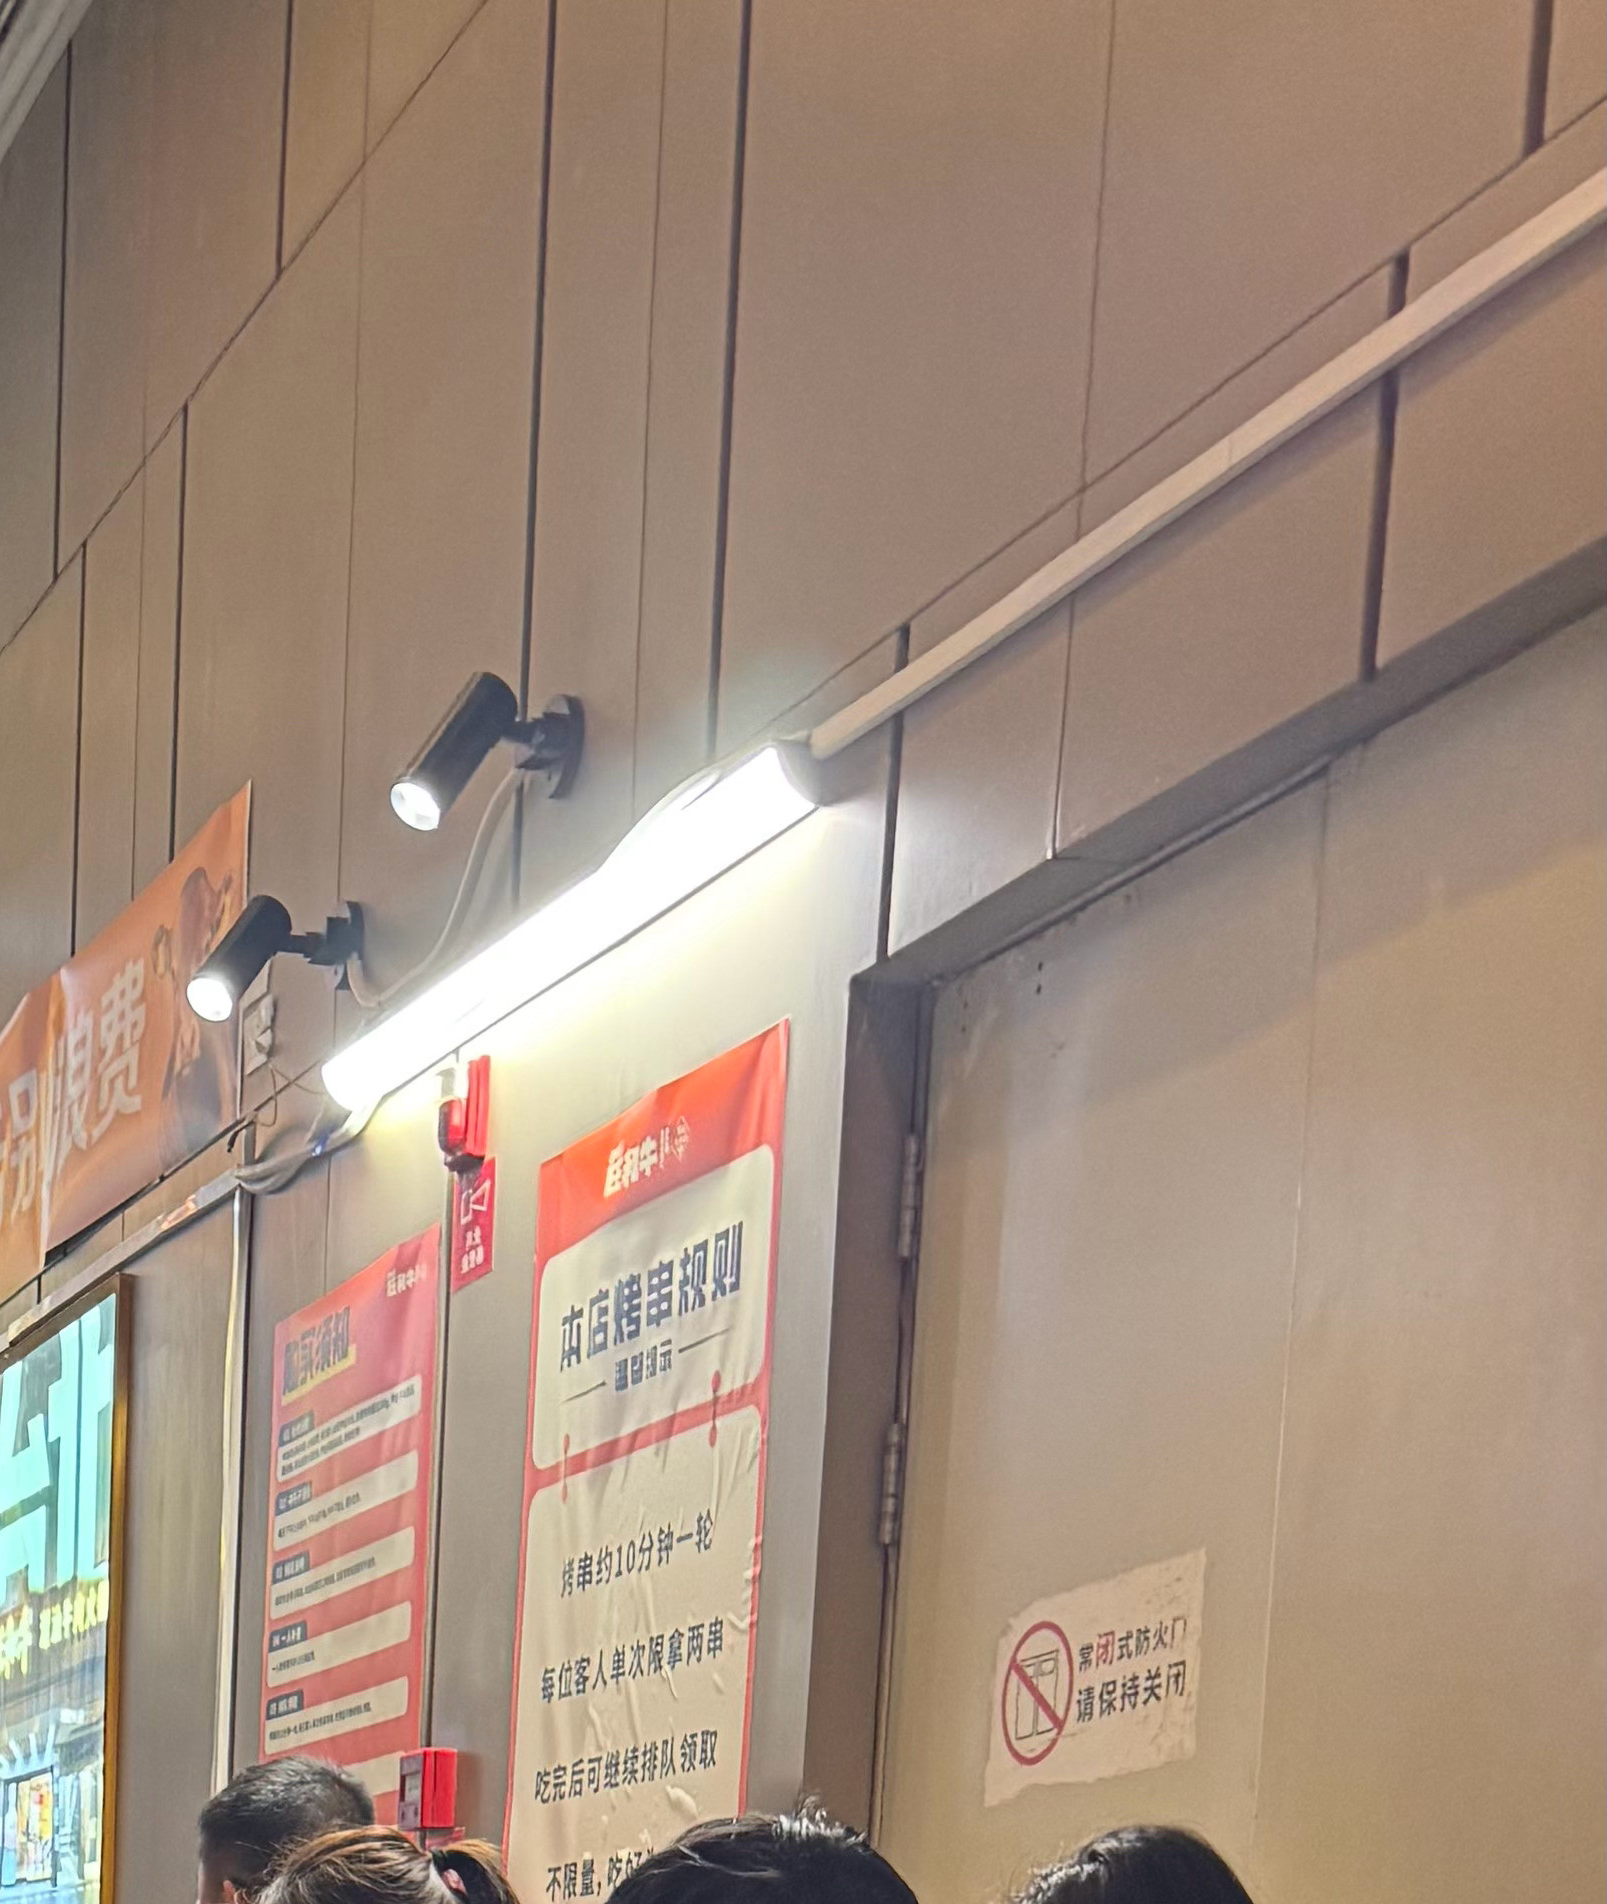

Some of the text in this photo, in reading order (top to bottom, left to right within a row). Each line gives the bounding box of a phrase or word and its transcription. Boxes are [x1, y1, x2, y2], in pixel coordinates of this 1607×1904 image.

[560, 1221, 743, 1372] 本店烤串规则
[561, 1508, 713, 1598] 烤串约10分钟一轮
[541, 1616, 724, 1703] 每位客人单次限拿两串
[1078, 1615, 1187, 1673] 常闭式防火门
[1076, 1660, 1186, 1724] 请保持关闭
[534, 1729, 719, 1805] 吃完后可继续排队领取
